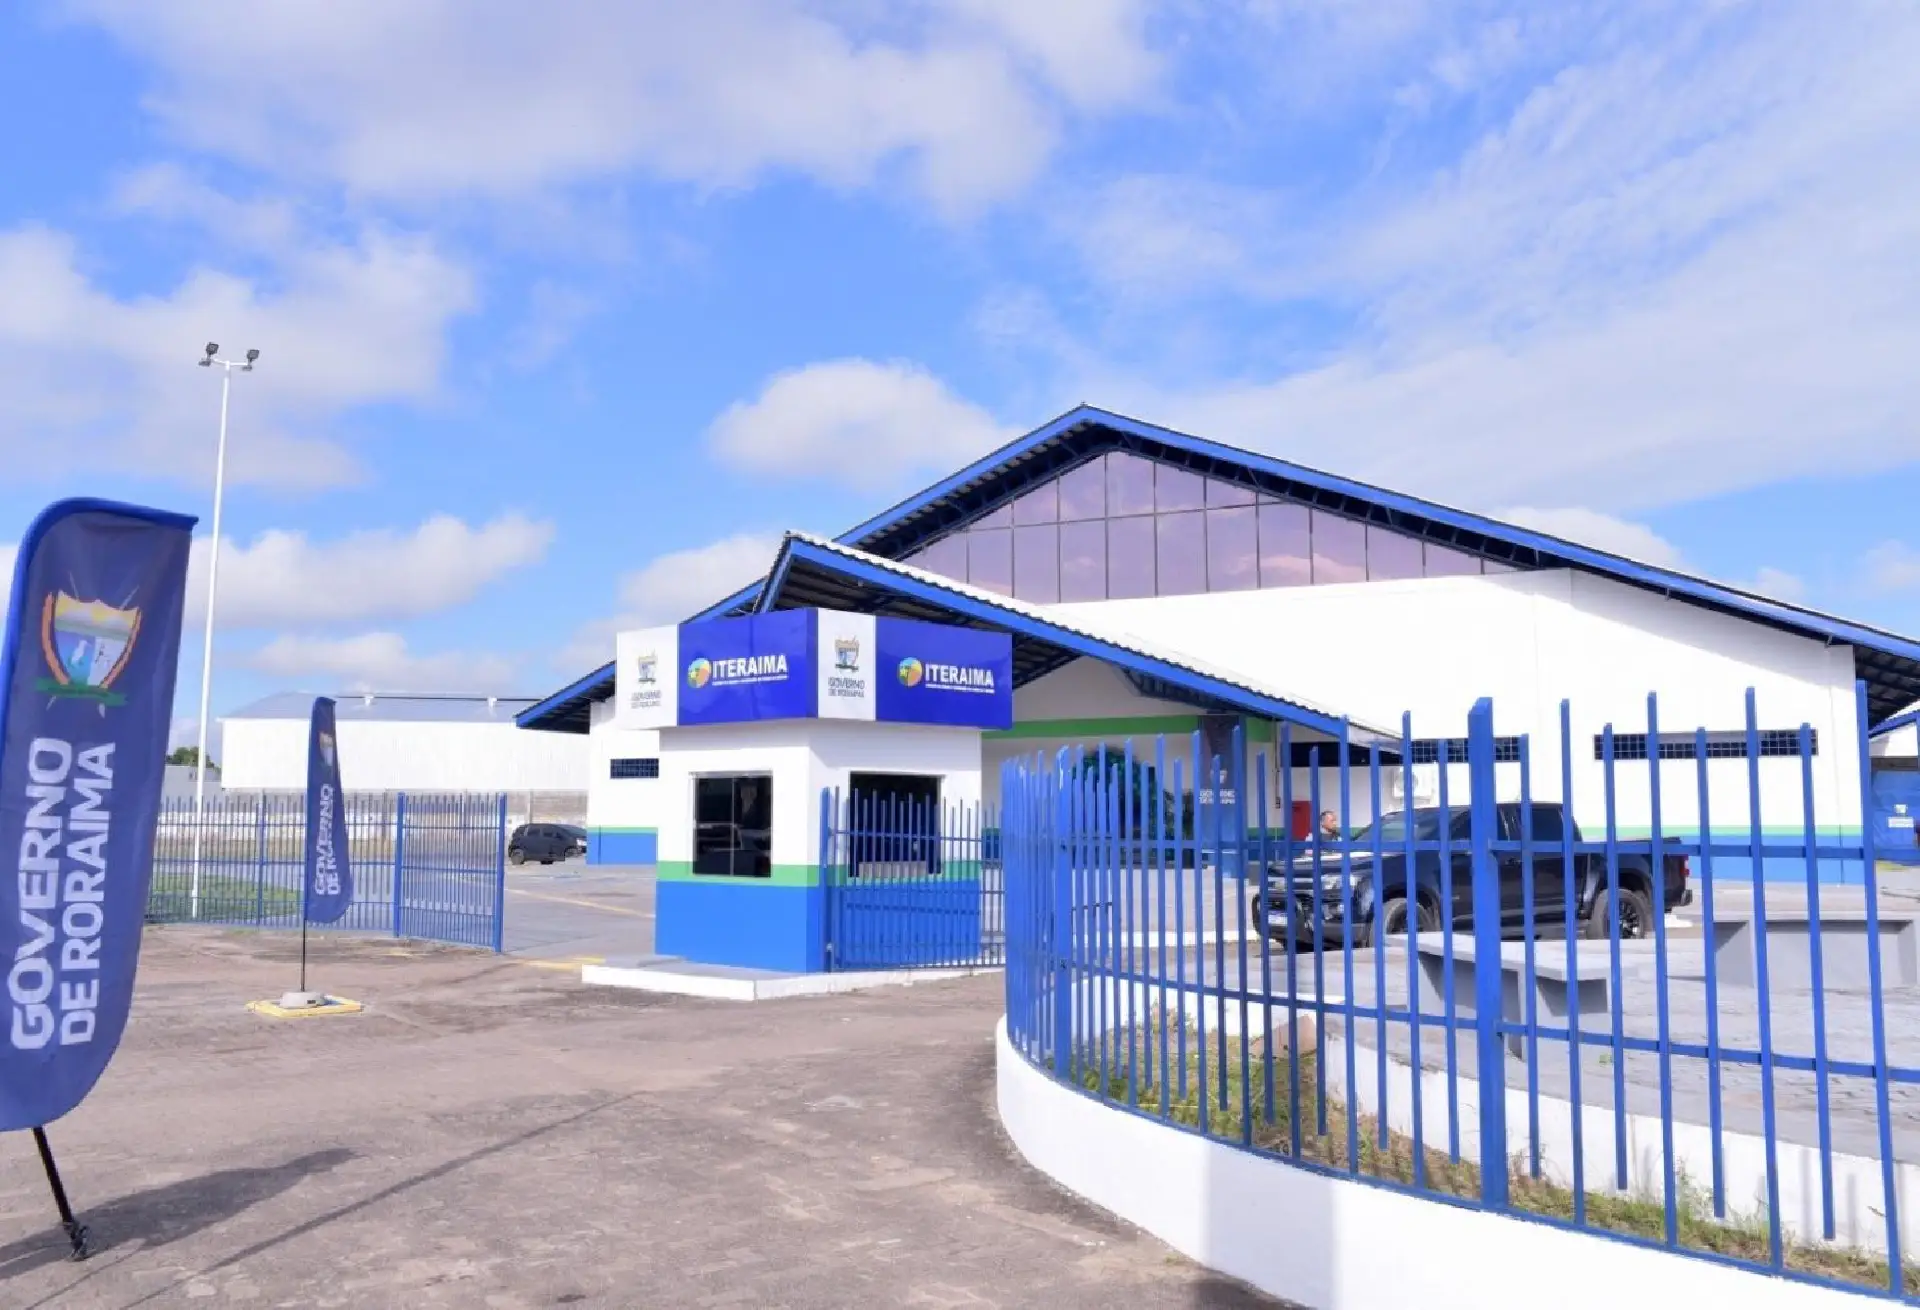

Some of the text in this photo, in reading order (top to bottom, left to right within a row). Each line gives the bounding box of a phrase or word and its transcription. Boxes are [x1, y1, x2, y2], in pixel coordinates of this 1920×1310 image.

[712, 654, 788, 679] ITERAIMA
[925, 663, 995, 687] ITERAIMA
[7, 737, 72, 1049] GOVERNO
[59, 742, 116, 1046] DE RORAIMA
[315, 783, 333, 895] GOVERNO
